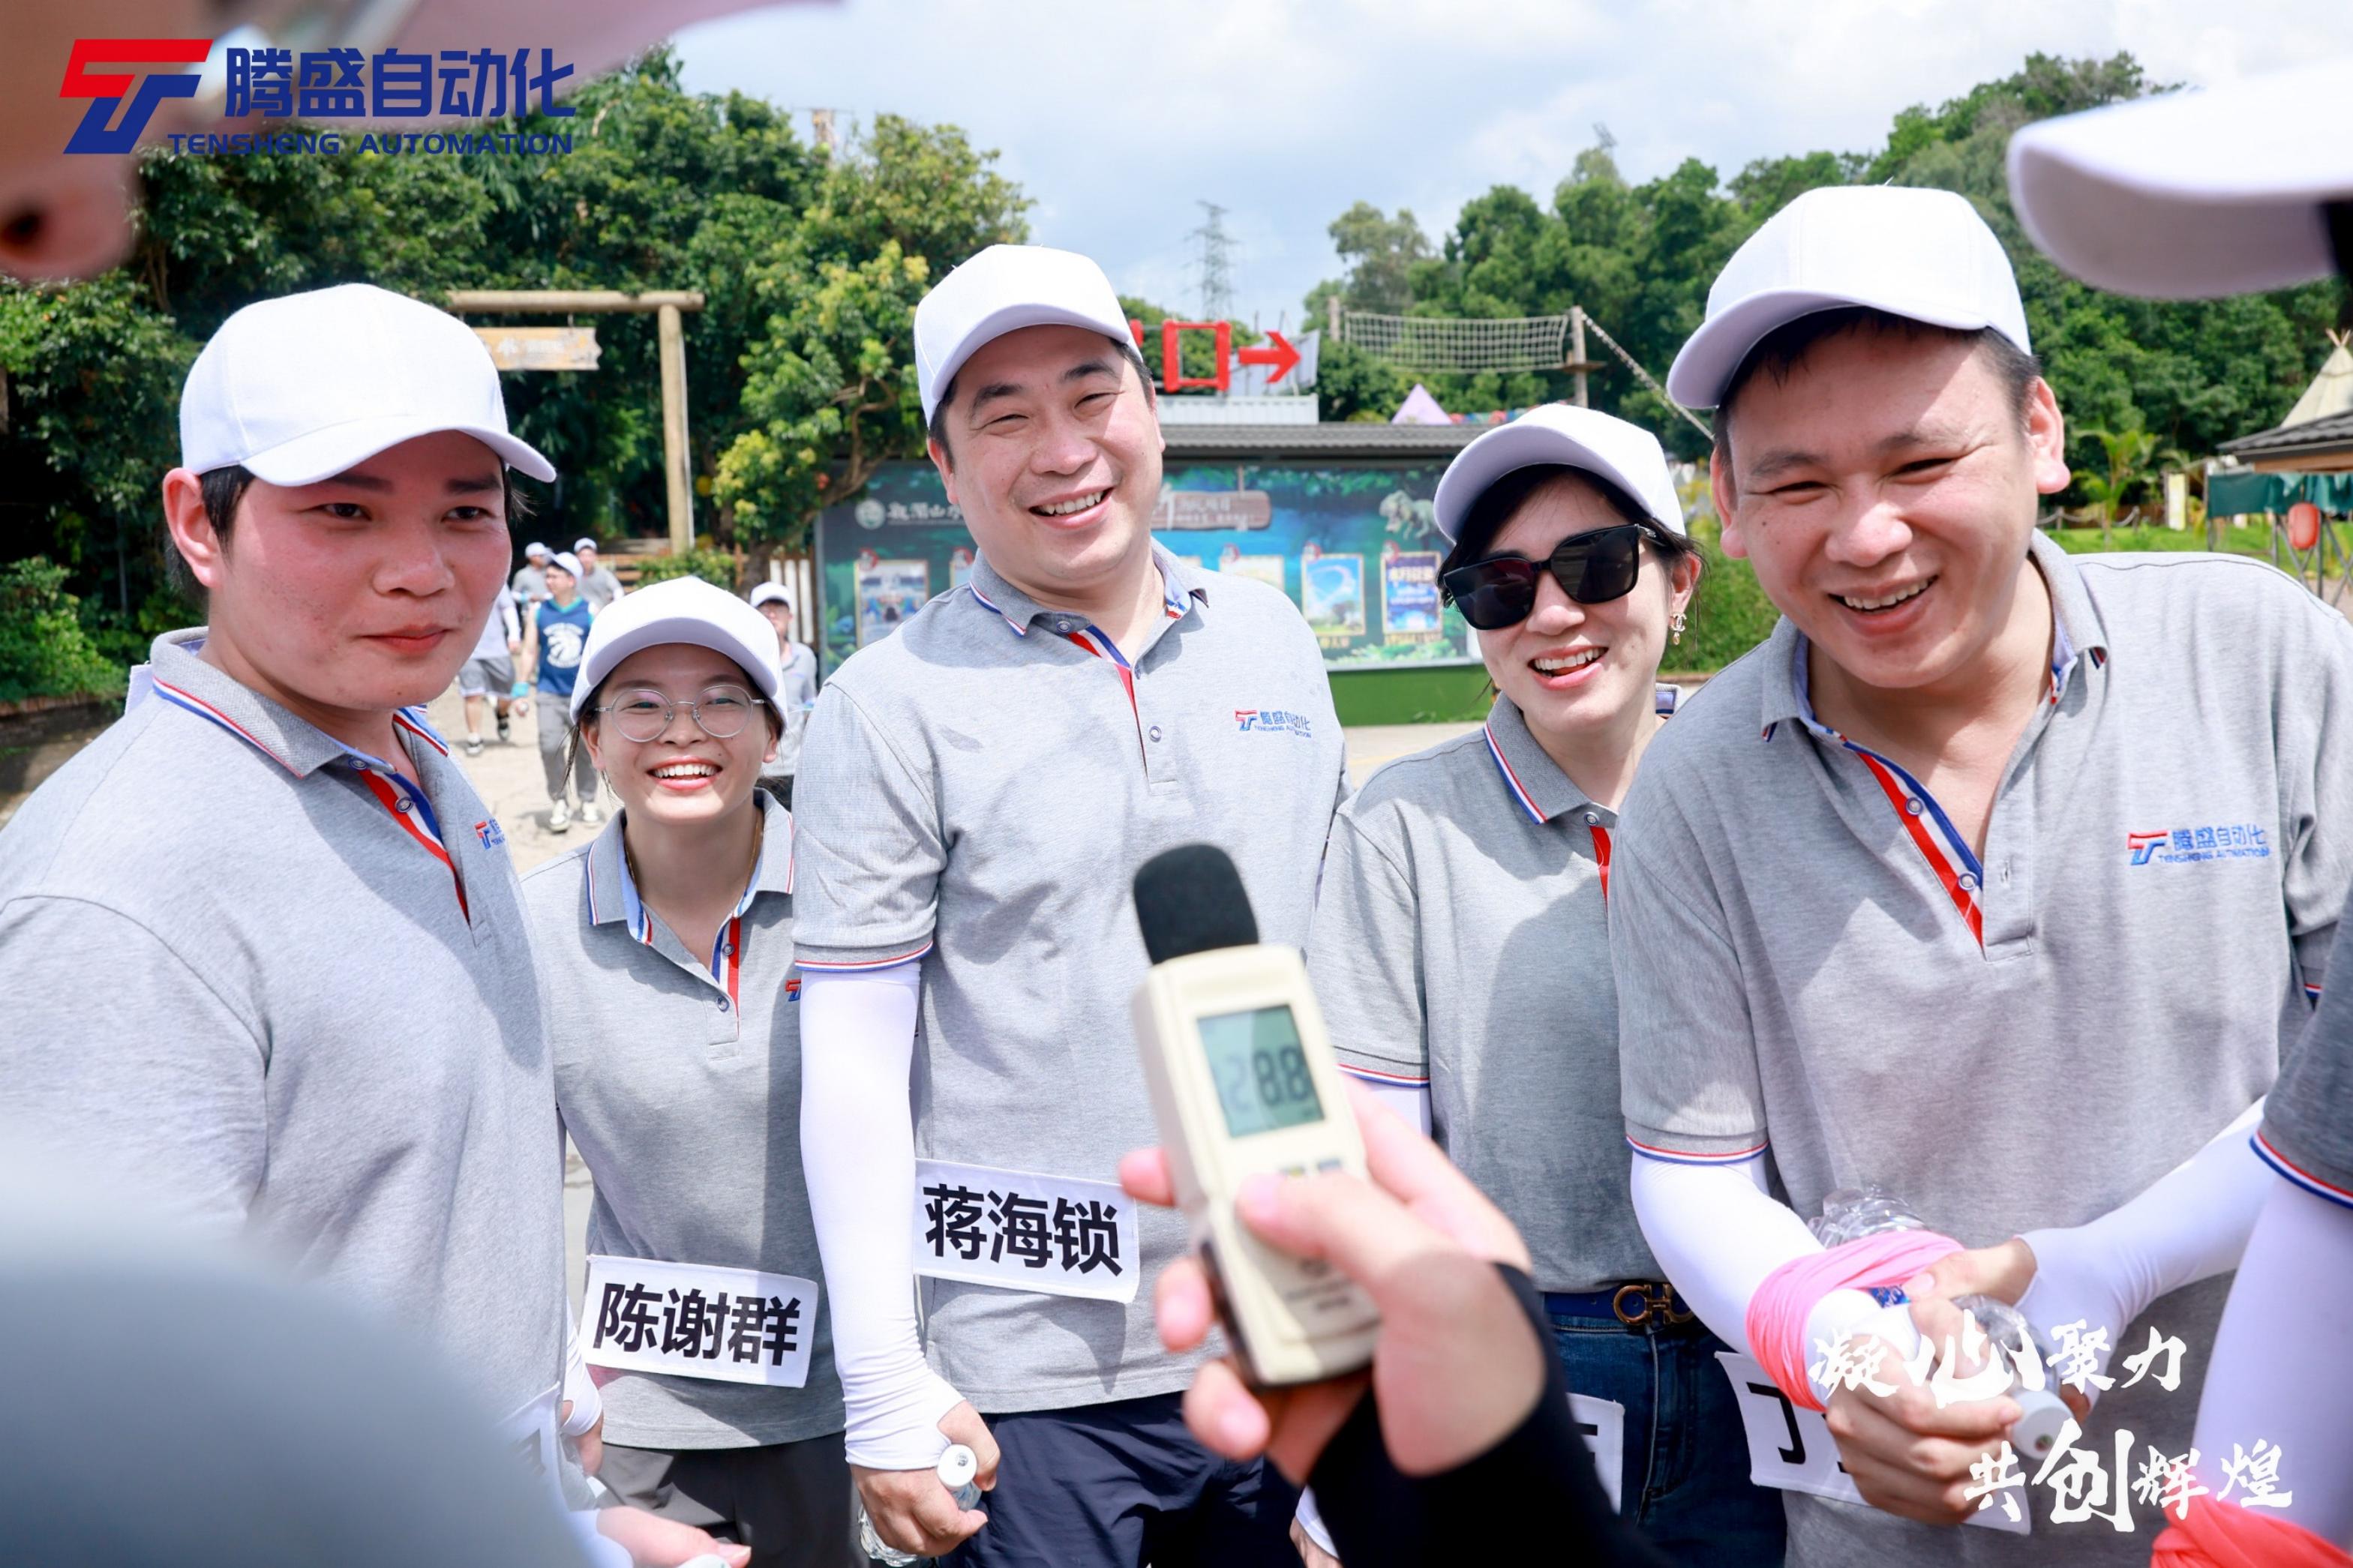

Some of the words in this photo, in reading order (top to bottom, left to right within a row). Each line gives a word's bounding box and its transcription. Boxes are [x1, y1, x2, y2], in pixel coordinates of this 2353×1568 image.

[2172, 824, 2267, 851] 腾盛自动化
[923, 1183, 1123, 1276] 蒋海锁
[593, 1283, 801, 1367] 陈谢群
